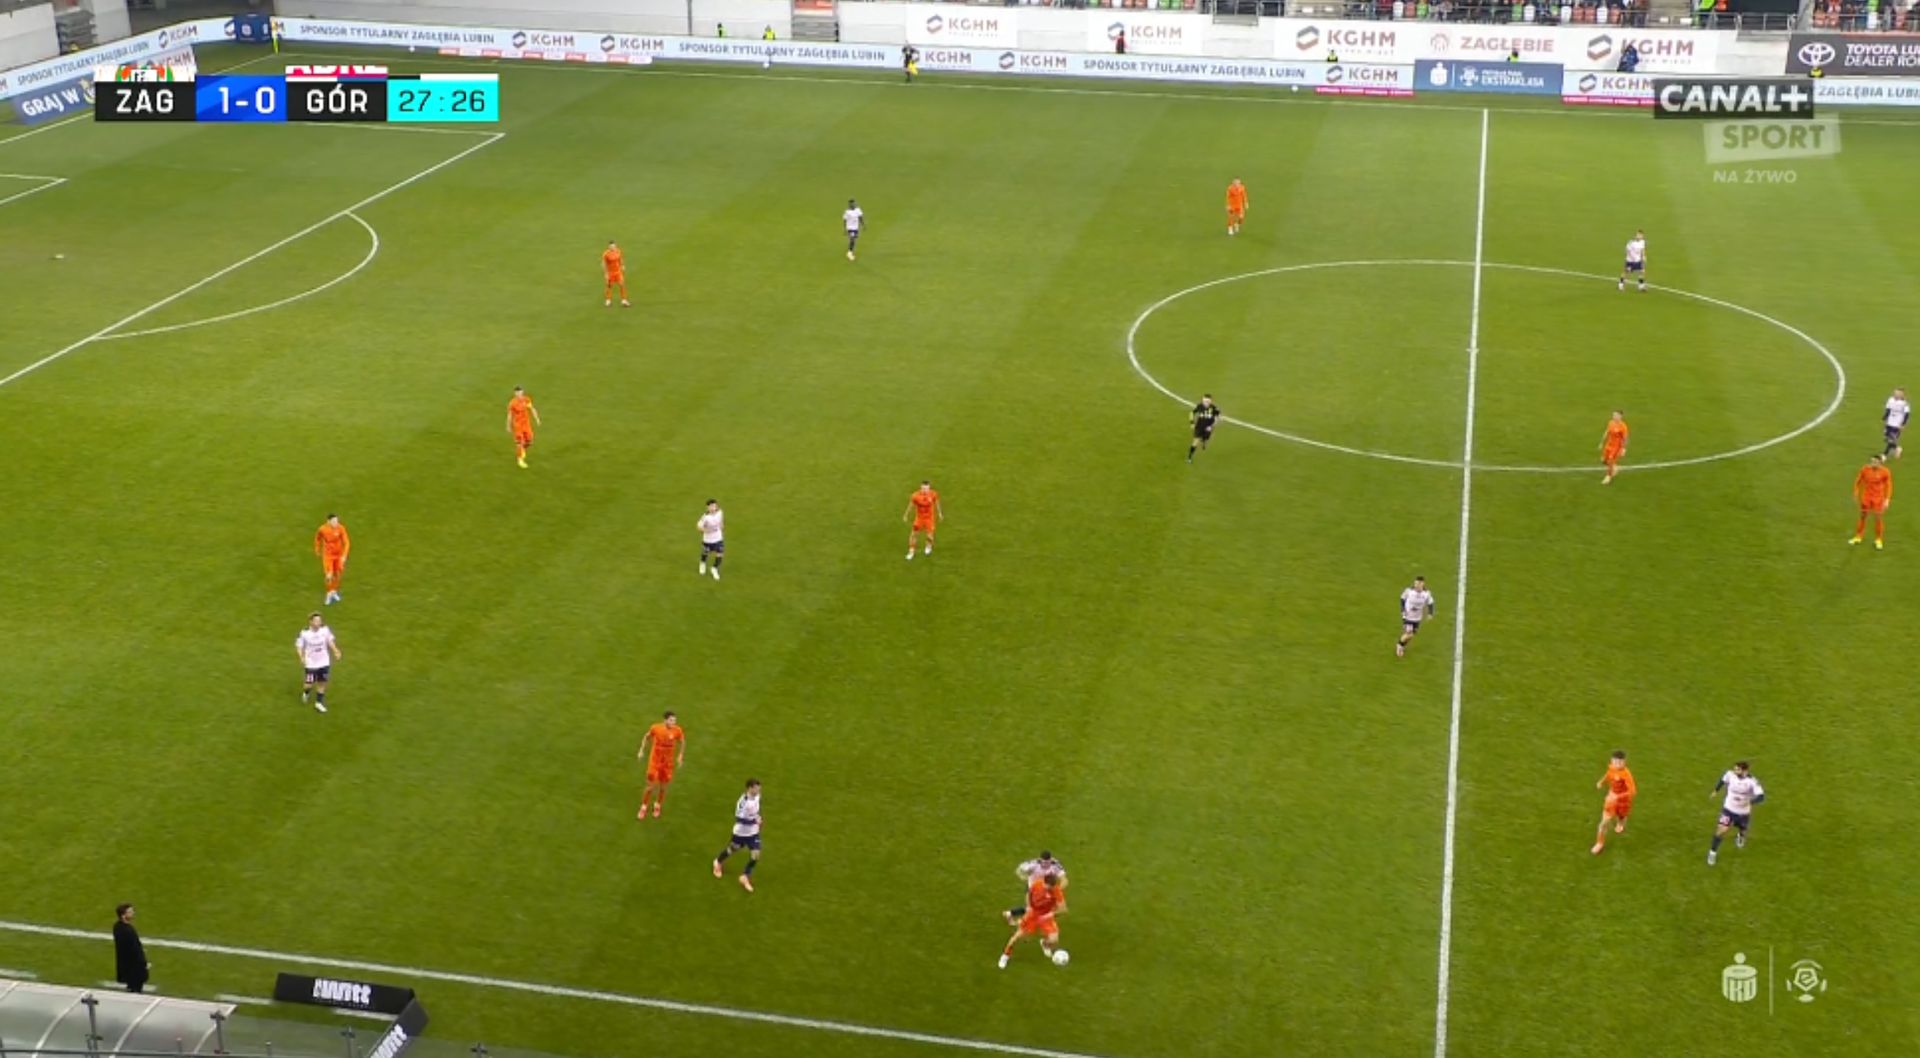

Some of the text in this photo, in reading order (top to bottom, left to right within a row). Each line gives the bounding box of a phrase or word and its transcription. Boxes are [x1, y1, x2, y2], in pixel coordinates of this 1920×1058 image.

[948, 18, 998, 31] KGHM
[300, 25, 347, 37] SPONSOR
[350, 27, 408, 39] TYTULARNY
[463, 32, 495, 44] LUBIN
[1131, 25, 1182, 39] KGHM
[1327, 29, 1396, 47] KGHM
[531, 34, 575, 47] KGHM
[620, 37, 665, 50] KGHM
[1622, 39, 1694, 56] KGHM
[679, 42, 728, 53] SPONSOR
[731, 44, 795, 57] TYTULARNY
[852, 49, 885, 61] LUBIN
[1846, 43, 1898, 55] TOYOTA
[925, 50, 972, 64] KGHM
[1020, 55, 1067, 68] KGHM
[1844, 55, 1895, 67] DEALER
[1084, 59, 1137, 71] SPONSOR
[1140, 61, 1209, 74] TYTULARNY
[1269, 67, 1306, 79] LUBIN
[1349, 67, 1398, 81] KGHM
[17, 68, 53, 86] SPONSOR
[1481, 75, 1544, 87] EKSTRAKLASA
[21, 88, 80, 116] GRAJ W
